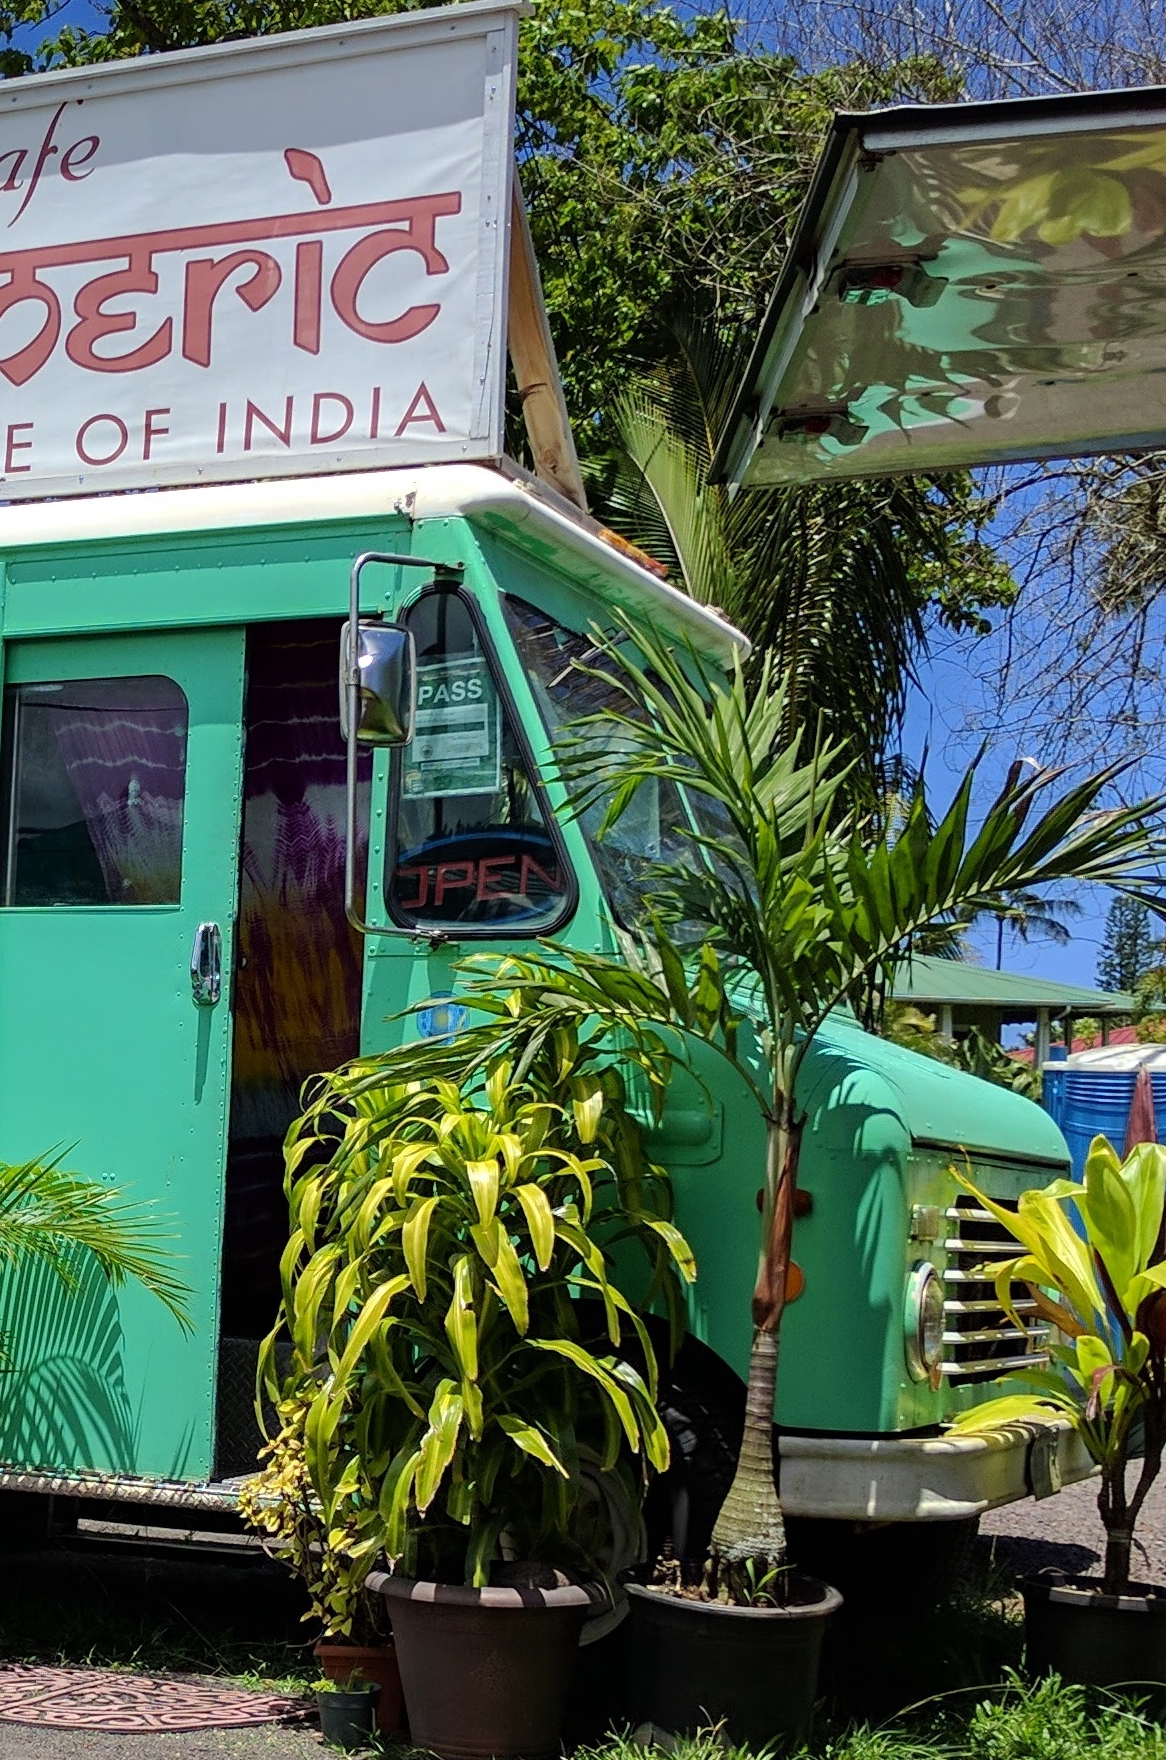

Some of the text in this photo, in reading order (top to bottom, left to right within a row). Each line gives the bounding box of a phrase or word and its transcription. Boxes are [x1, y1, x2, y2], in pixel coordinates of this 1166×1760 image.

[75, 407, 172, 466] OF
[217, 380, 448, 454] INDIA
[417, 678, 483, 706] PASS
